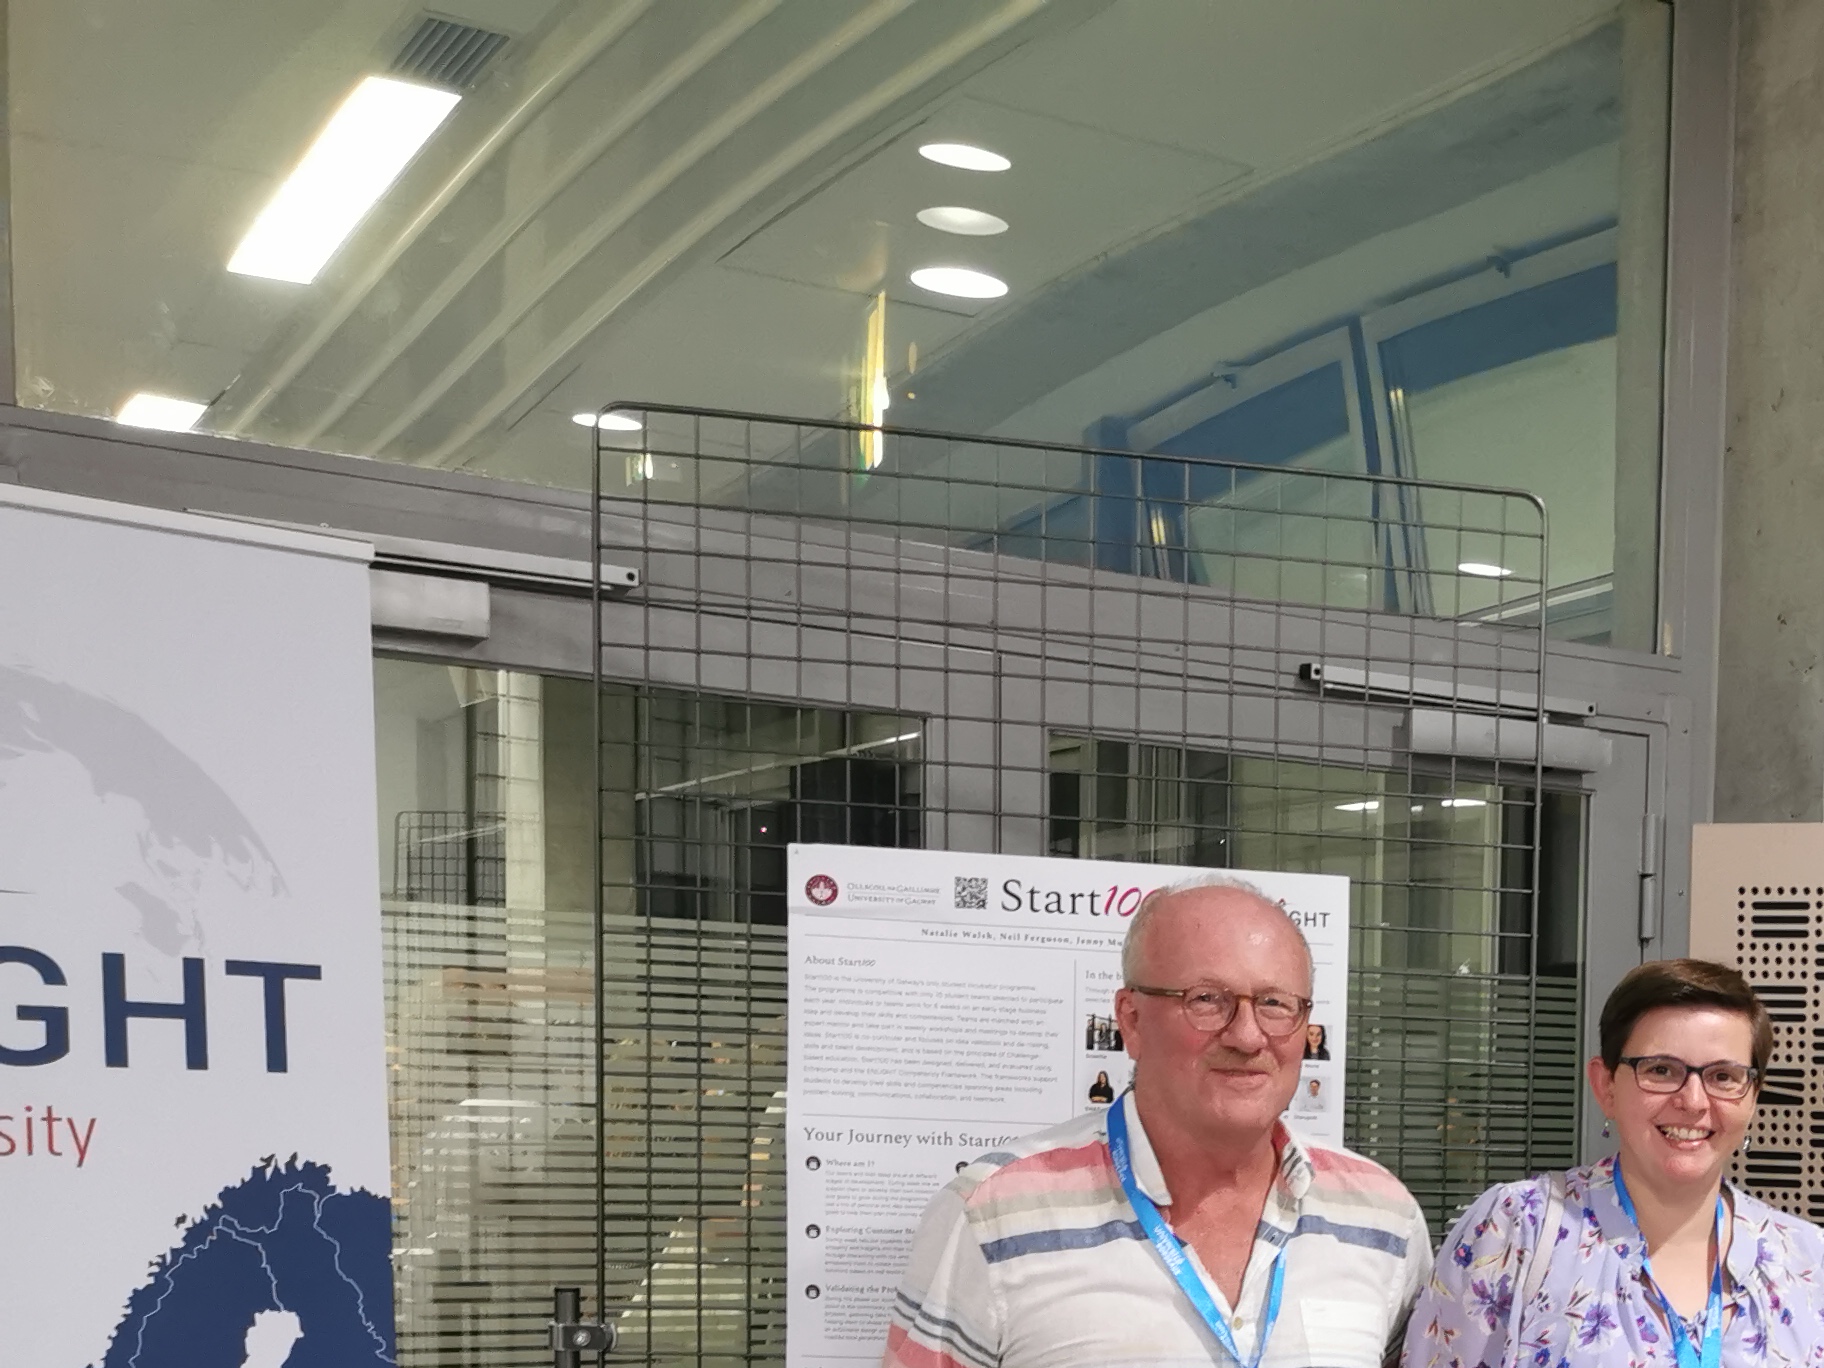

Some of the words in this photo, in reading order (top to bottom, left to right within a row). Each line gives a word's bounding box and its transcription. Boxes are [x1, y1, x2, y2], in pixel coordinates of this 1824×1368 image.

[1001, 878, 1156, 917] Start10
[920, 928, 958, 939] Natalie
[1000, 932, 1021, 942] Neil
[804, 956, 835, 966] About
[803, 1127, 844, 1143] Your
[848, 1129, 911, 1148] Journey
[916, 1131, 953, 1147] with
